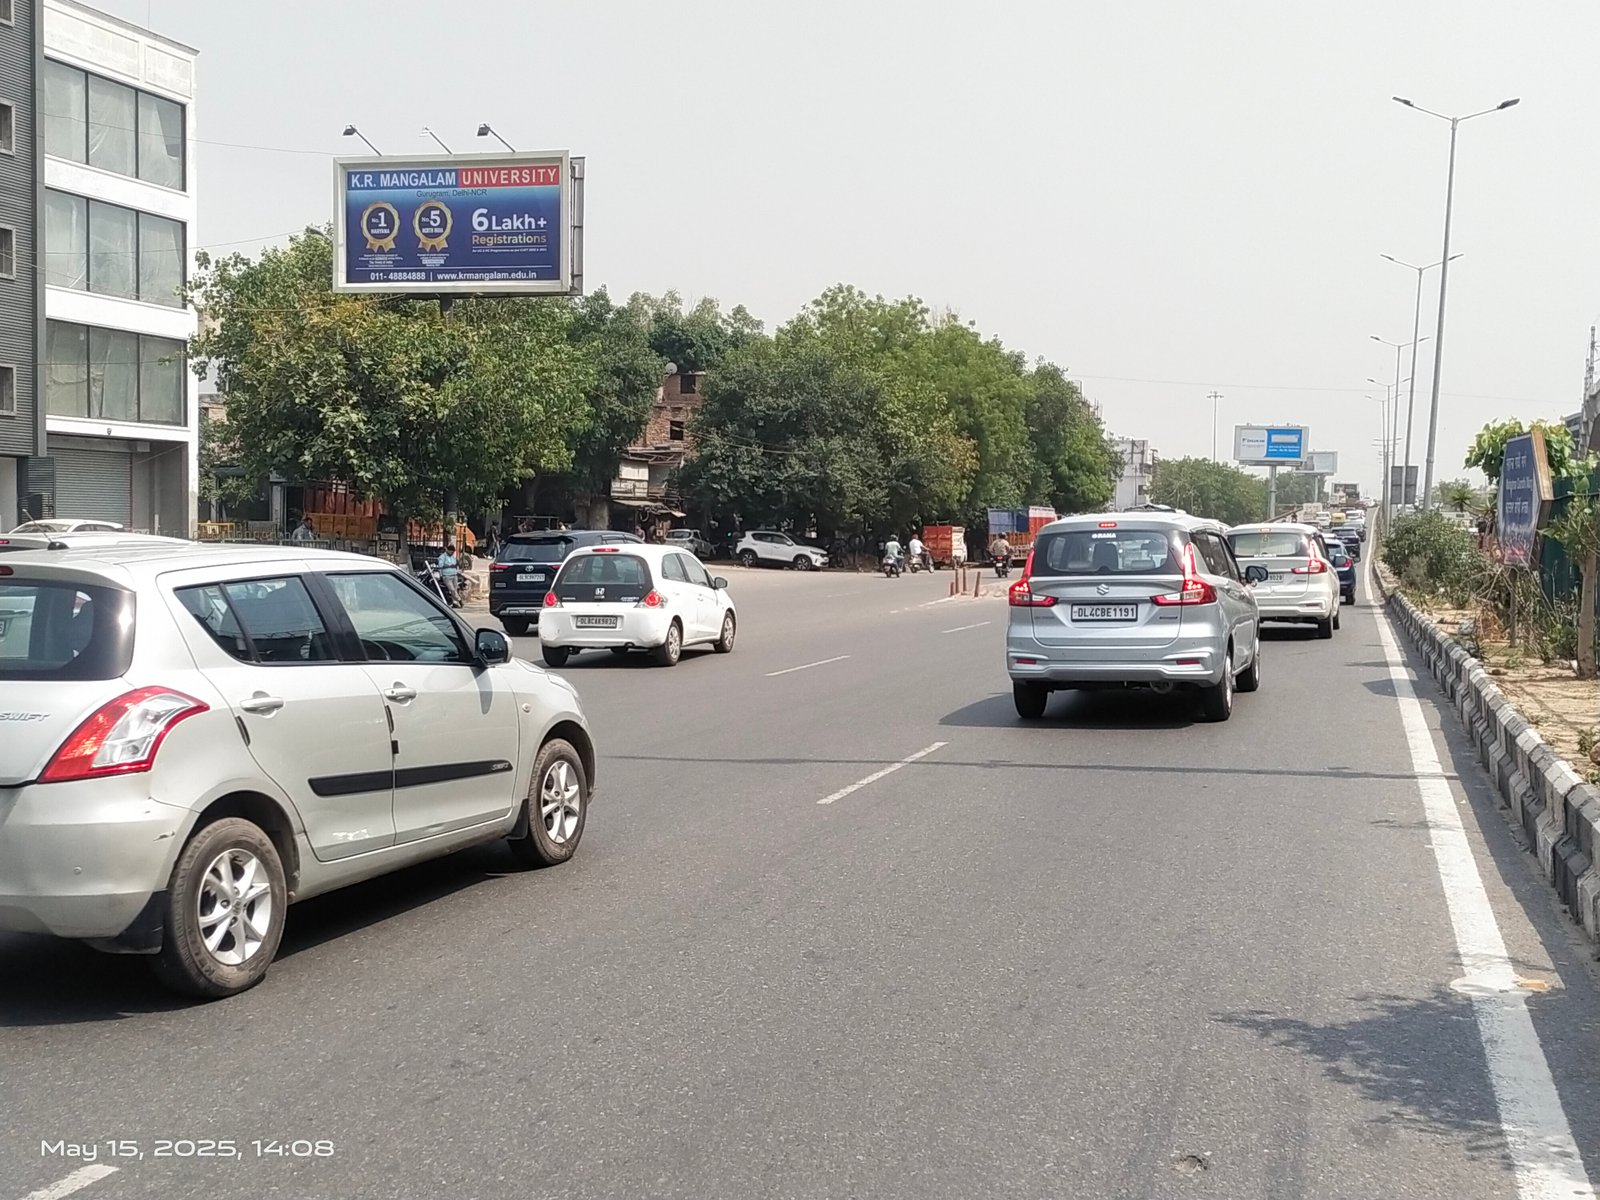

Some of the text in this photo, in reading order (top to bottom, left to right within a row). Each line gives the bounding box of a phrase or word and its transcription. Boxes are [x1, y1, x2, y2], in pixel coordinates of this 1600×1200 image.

[351, 168, 557, 188] K.R. MANGALAM UNIVERSITY
[452, 188, 487, 197] Delhi-NCR
[471, 207, 489, 232] 6
[471, 233, 547, 246] Registrations
[436, 271, 537, 282] www.krmangalam.edu.in
[1077, 607, 1135, 618] DL4CBE1191
